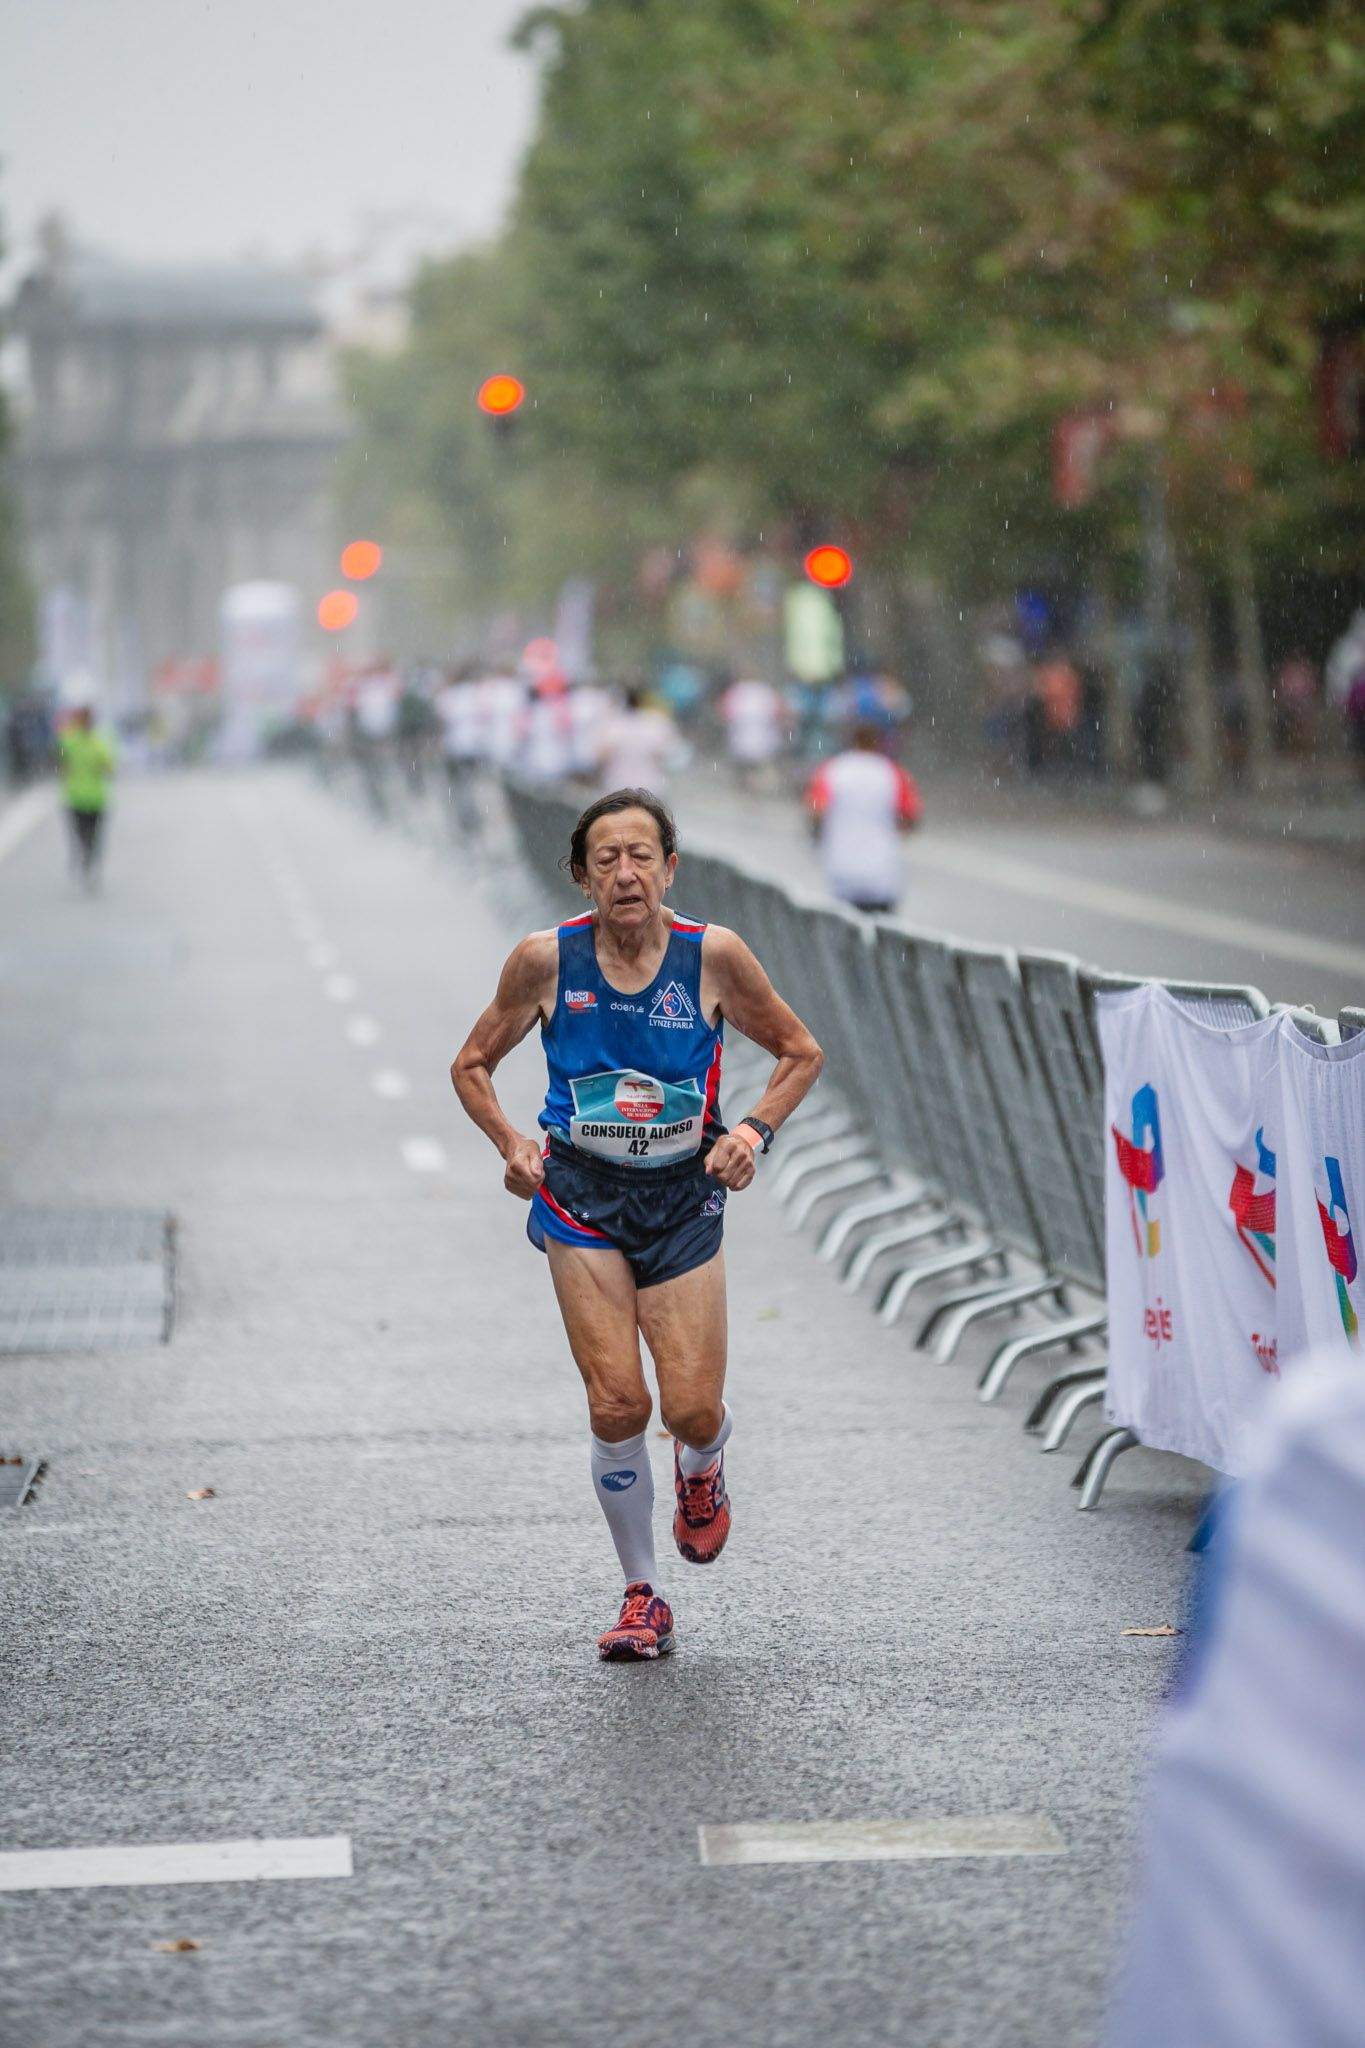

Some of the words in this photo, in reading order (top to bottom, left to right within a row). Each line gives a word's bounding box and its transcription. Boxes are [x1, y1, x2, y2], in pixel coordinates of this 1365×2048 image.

[652, 989, 663, 1004] CLUB
[649, 1019, 671, 1028] LYNZE
[581, 1124, 646, 1139] CONSUELO
[650, 1119, 693, 1139] ALONSO
[628, 1140, 649, 1156] 42
